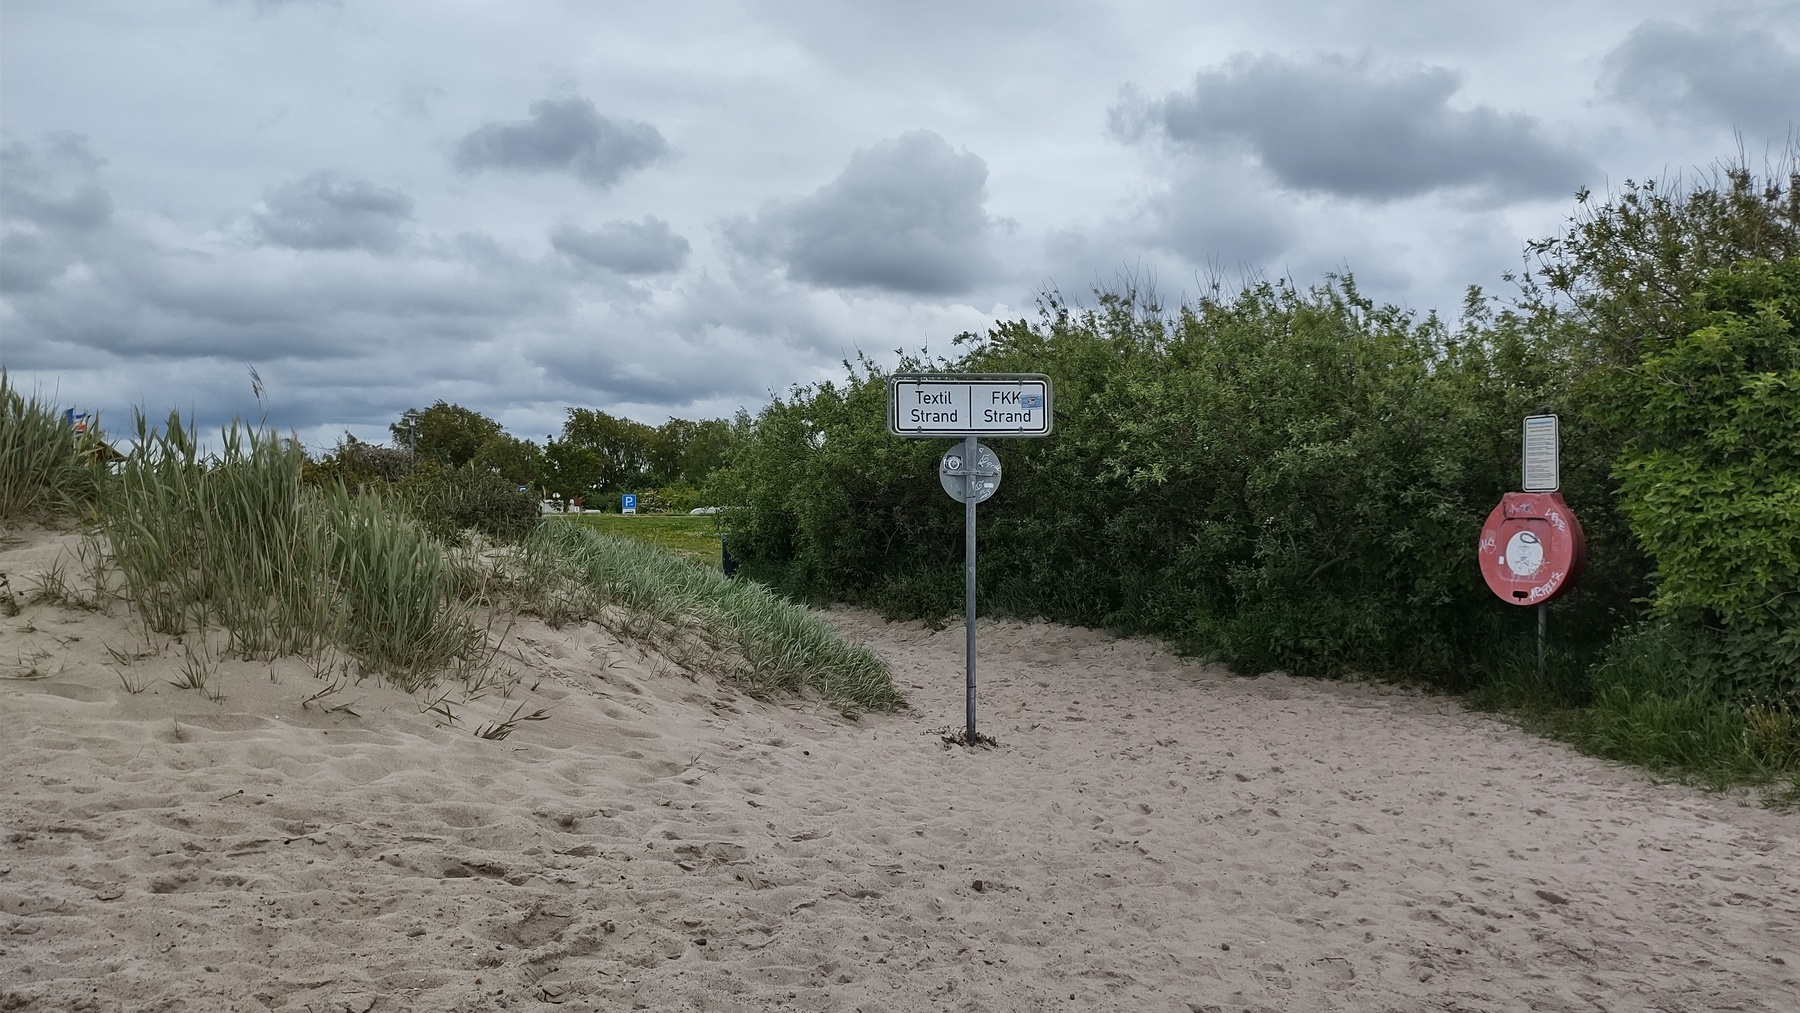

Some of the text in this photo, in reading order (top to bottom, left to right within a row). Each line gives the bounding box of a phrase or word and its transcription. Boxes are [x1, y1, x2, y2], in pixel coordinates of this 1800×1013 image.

[915, 390, 953, 405] Textil
[991, 390, 1022, 405] FKK
[911, 408, 958, 423] Strand
[984, 408, 1031, 423] Strand
